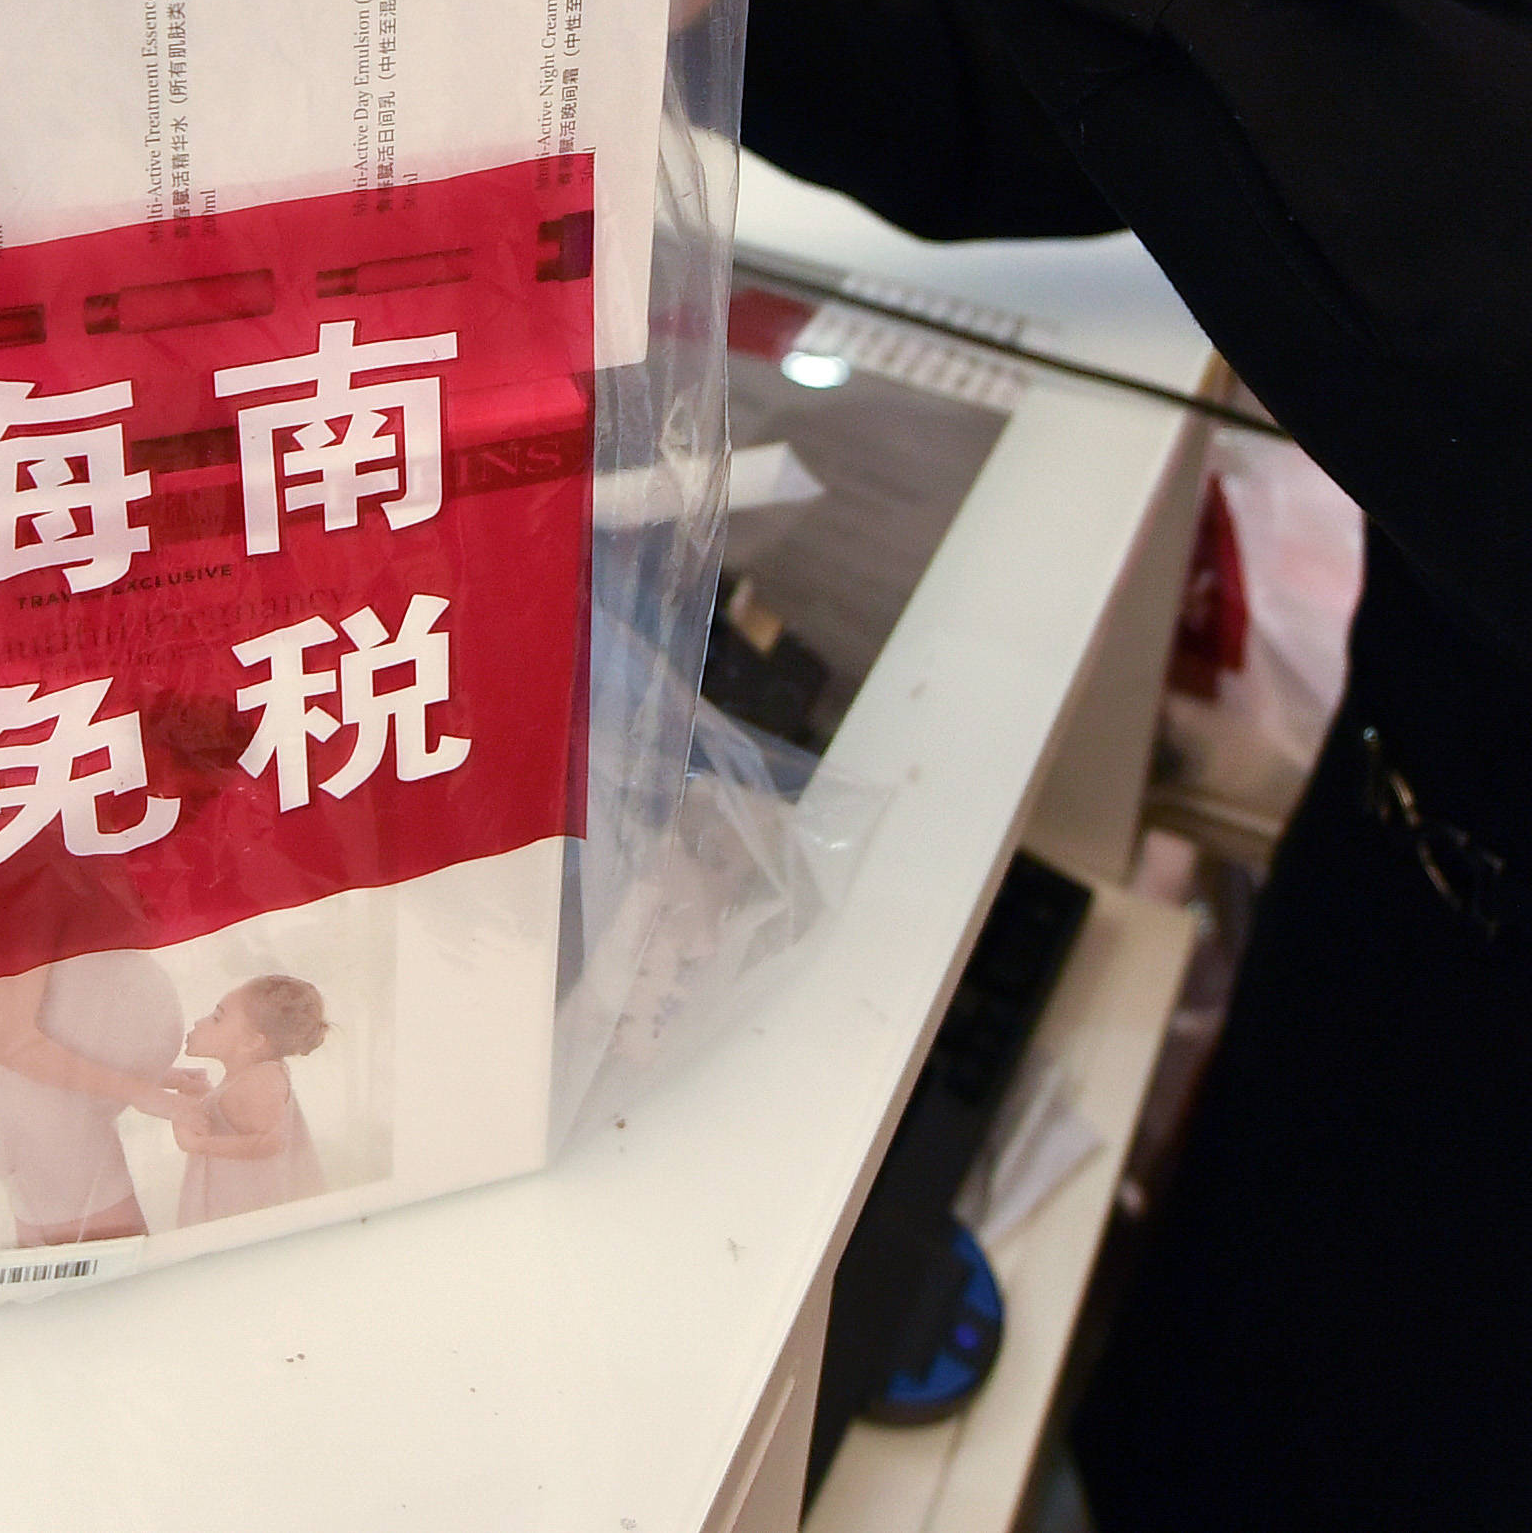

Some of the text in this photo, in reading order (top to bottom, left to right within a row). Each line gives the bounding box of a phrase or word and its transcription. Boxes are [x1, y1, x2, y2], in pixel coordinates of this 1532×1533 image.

[352, 10, 370, 86] Emulsion
[539, 53, 558, 97] Night
[144, 62, 161, 148] Treatment
[353, 90, 373, 121] Day
[534, 101, 554, 190] Mi-Active
[111, 564, 233, 596] EXCLUSIVE
